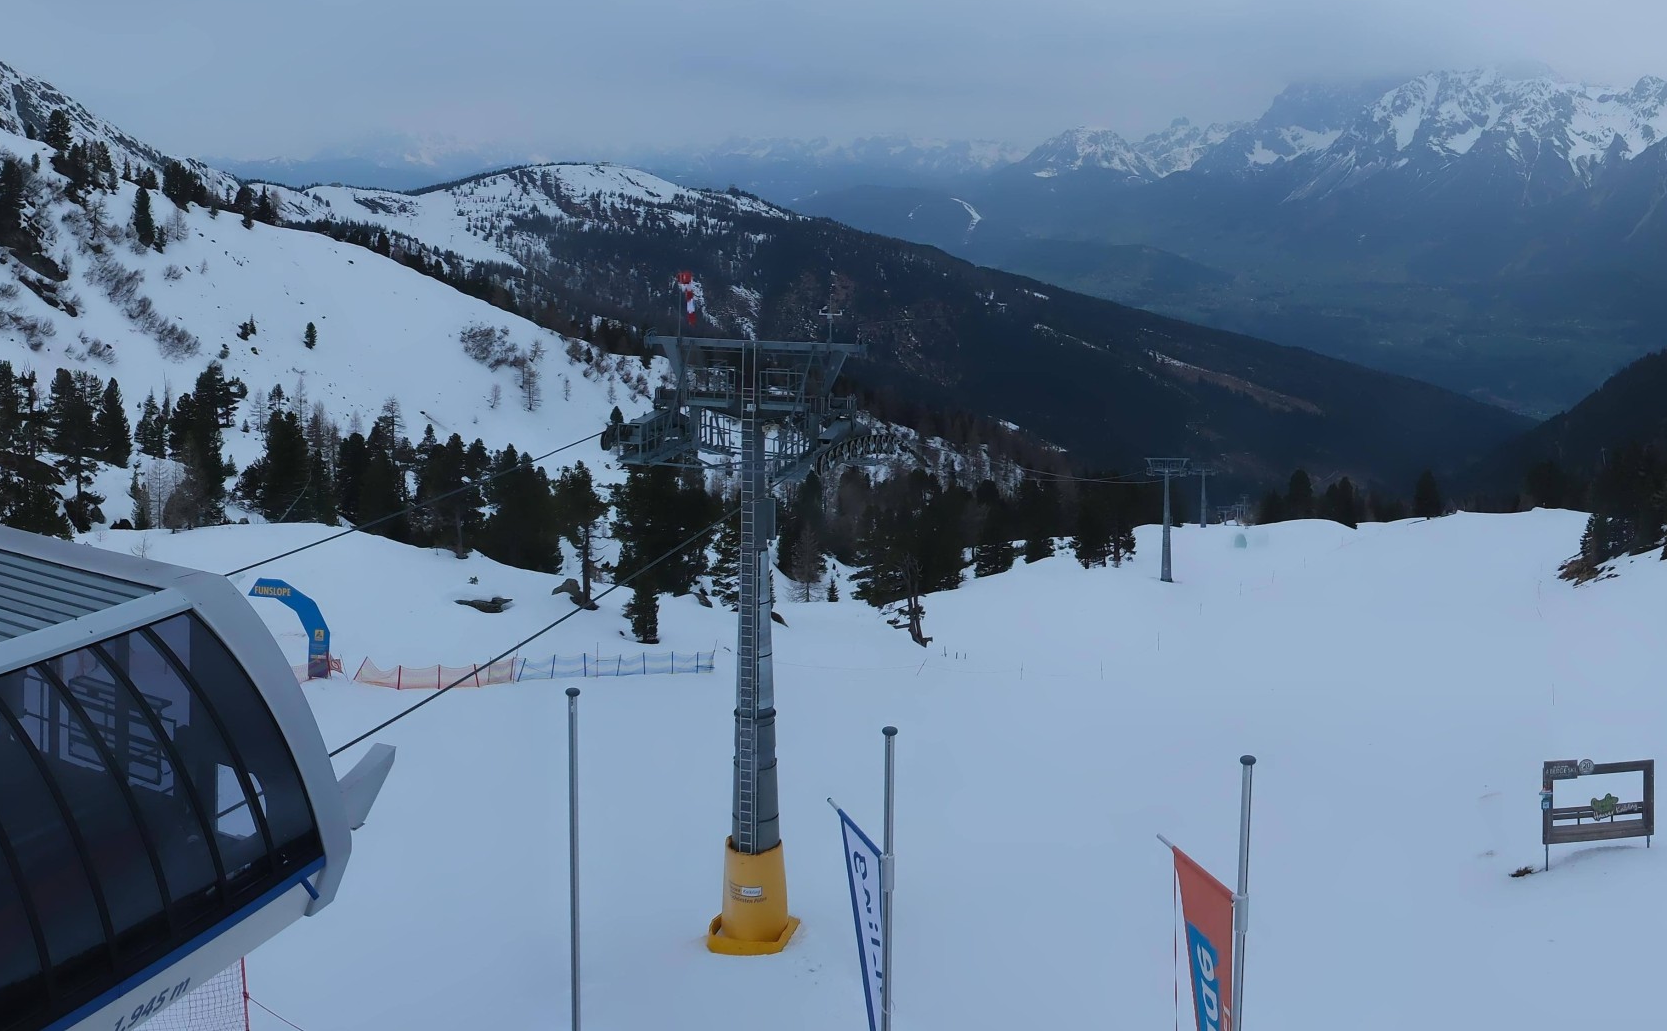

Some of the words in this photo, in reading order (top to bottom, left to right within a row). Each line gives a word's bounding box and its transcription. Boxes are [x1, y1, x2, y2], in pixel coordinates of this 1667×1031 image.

[254, 585, 291, 597] FUNSLOPE
[114, 987, 170, 1031] 1.945
[170, 977, 191, 1001] m
